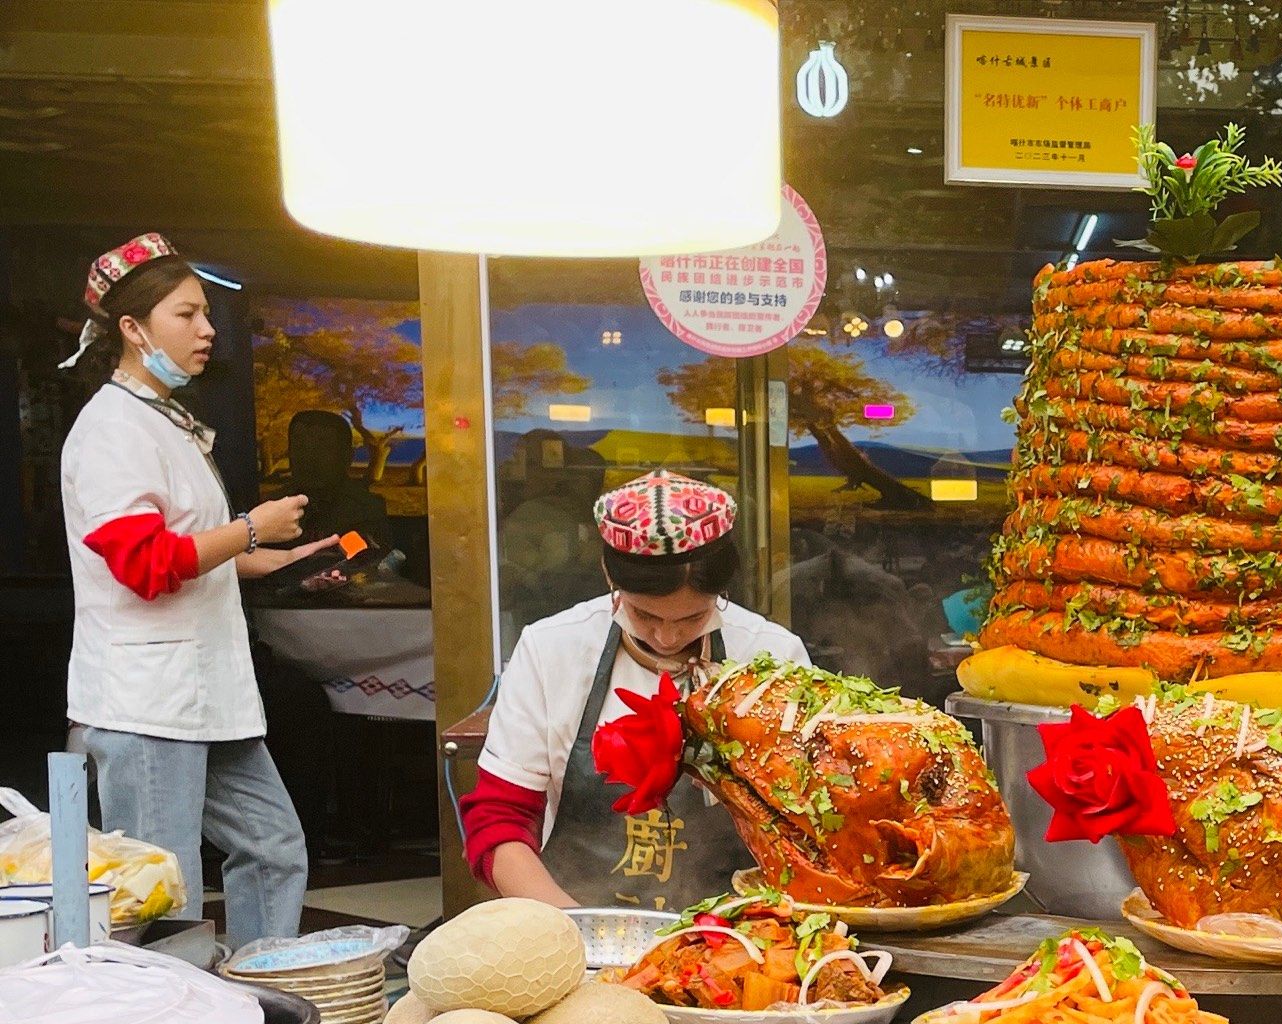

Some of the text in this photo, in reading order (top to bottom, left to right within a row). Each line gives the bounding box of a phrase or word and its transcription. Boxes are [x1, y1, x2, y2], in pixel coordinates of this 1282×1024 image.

[1056, 96, 1127, 112] 个体工商户
[660, 255, 804, 274] 喀什市正在创建全国
[661, 271, 803, 289] 民族团结进步示范市
[679, 289, 787, 307] 感谢您的参与支持
